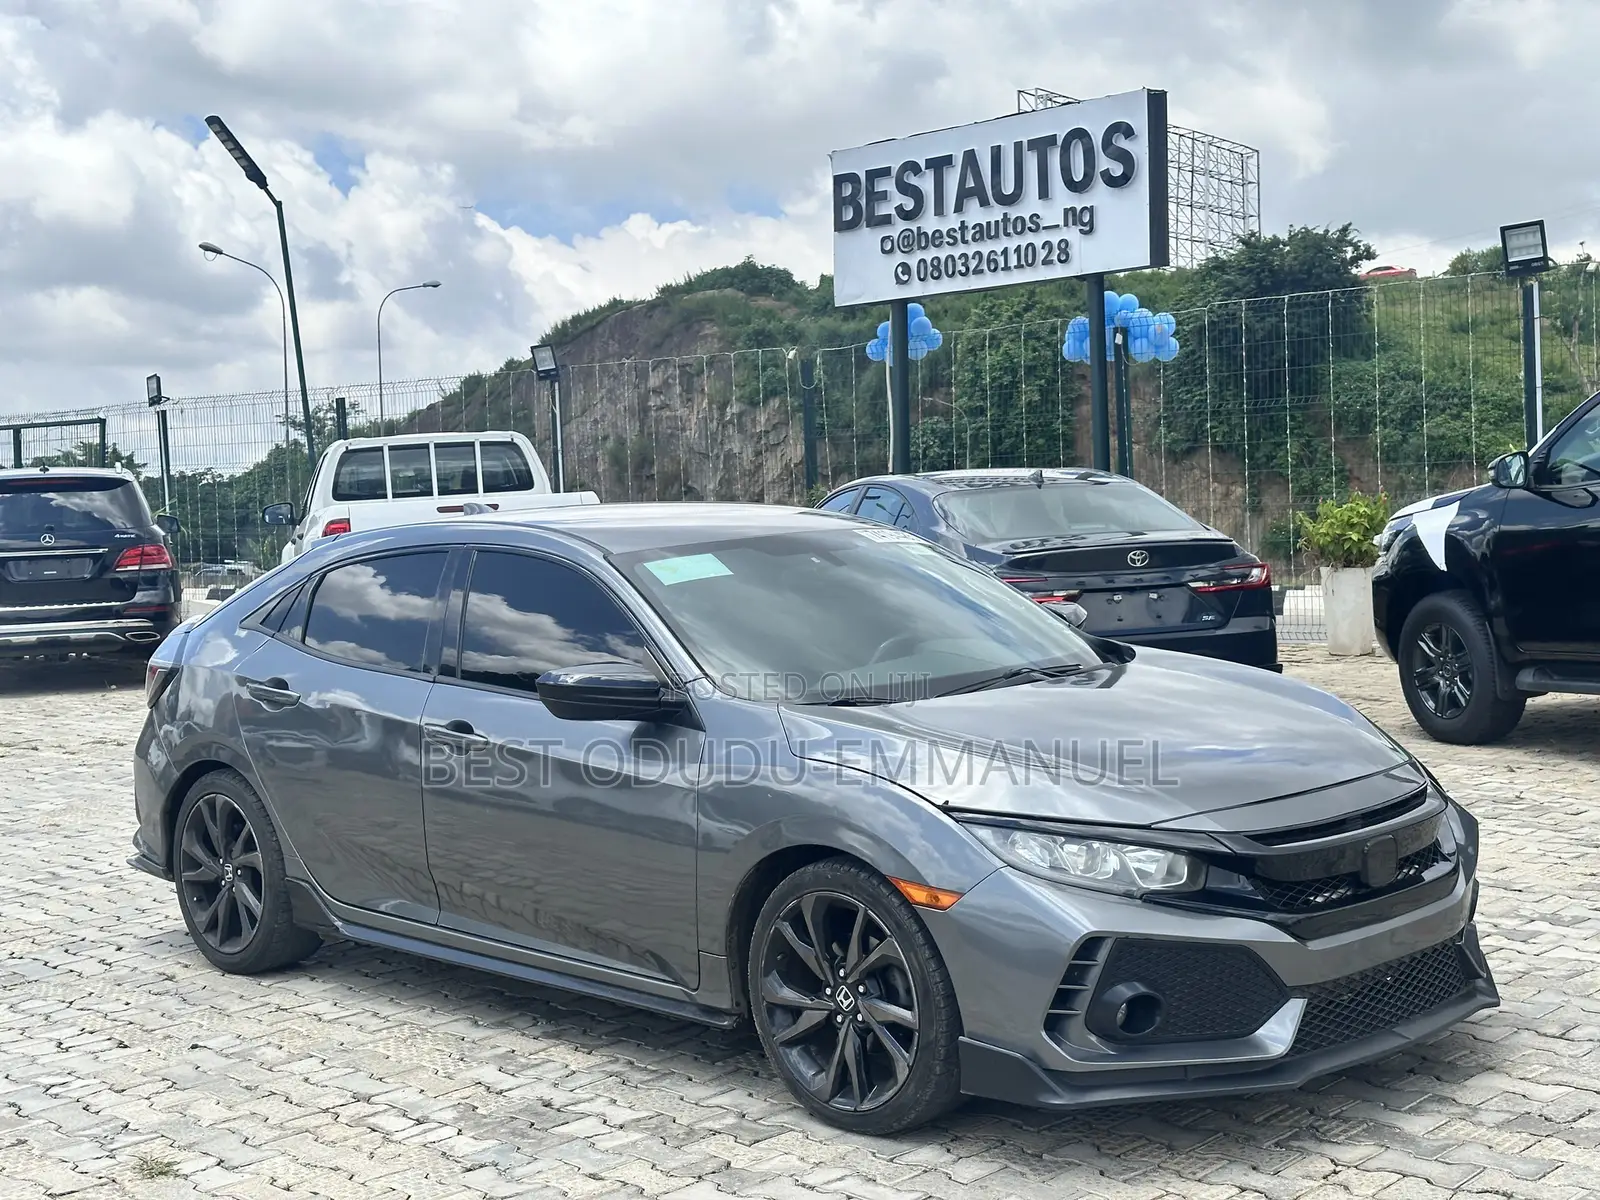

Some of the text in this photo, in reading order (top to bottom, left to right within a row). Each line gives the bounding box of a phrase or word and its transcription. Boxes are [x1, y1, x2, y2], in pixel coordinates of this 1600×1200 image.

[833, 121, 1137, 232] BESTAUTOS
[896, 205, 1094, 254] @bestautos_ng
[916, 238, 1070, 281] 08032611028
